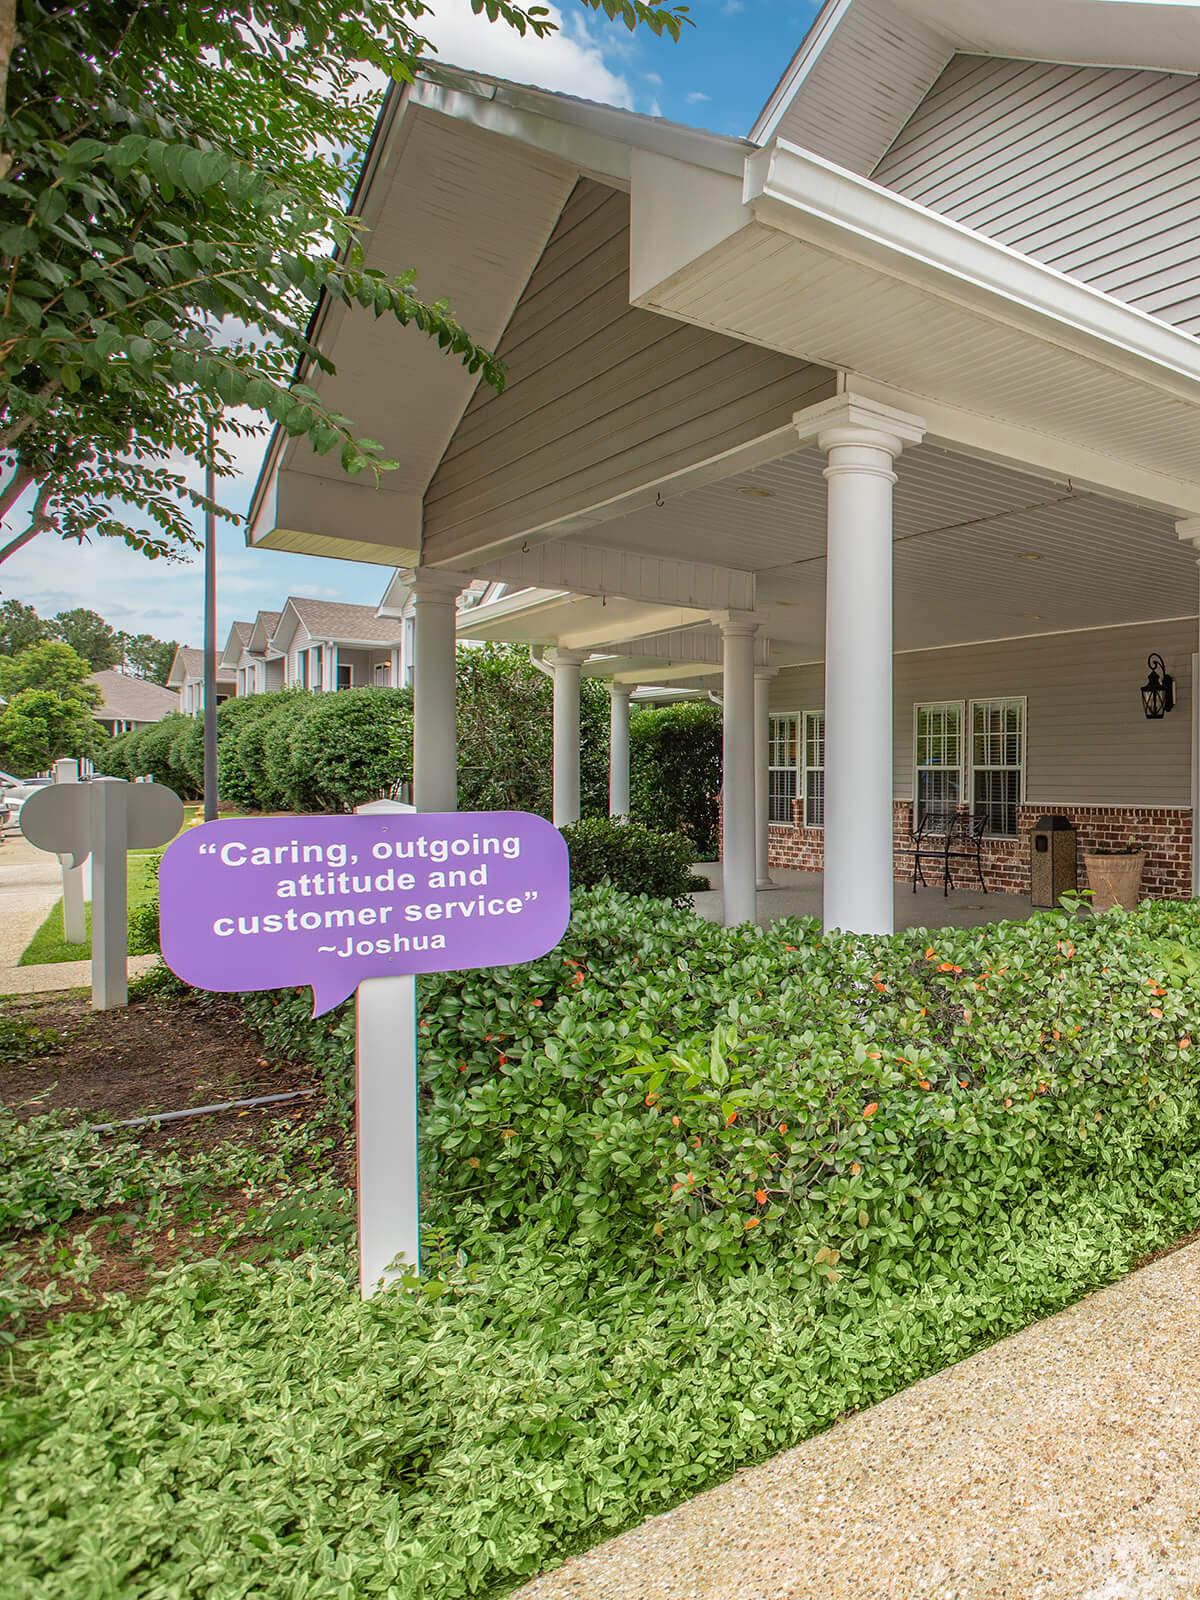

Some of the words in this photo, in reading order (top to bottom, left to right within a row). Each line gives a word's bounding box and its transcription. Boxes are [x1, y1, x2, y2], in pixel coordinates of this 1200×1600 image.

[199, 841, 358, 868] “Caring,
[372, 834, 521, 862] outgoing
[276, 868, 416, 898] attitude
[428, 864, 488, 890] and
[213, 906, 393, 937] customer
[404, 890, 538, 924] service”
[317, 933, 447, 958] ~Joshua
